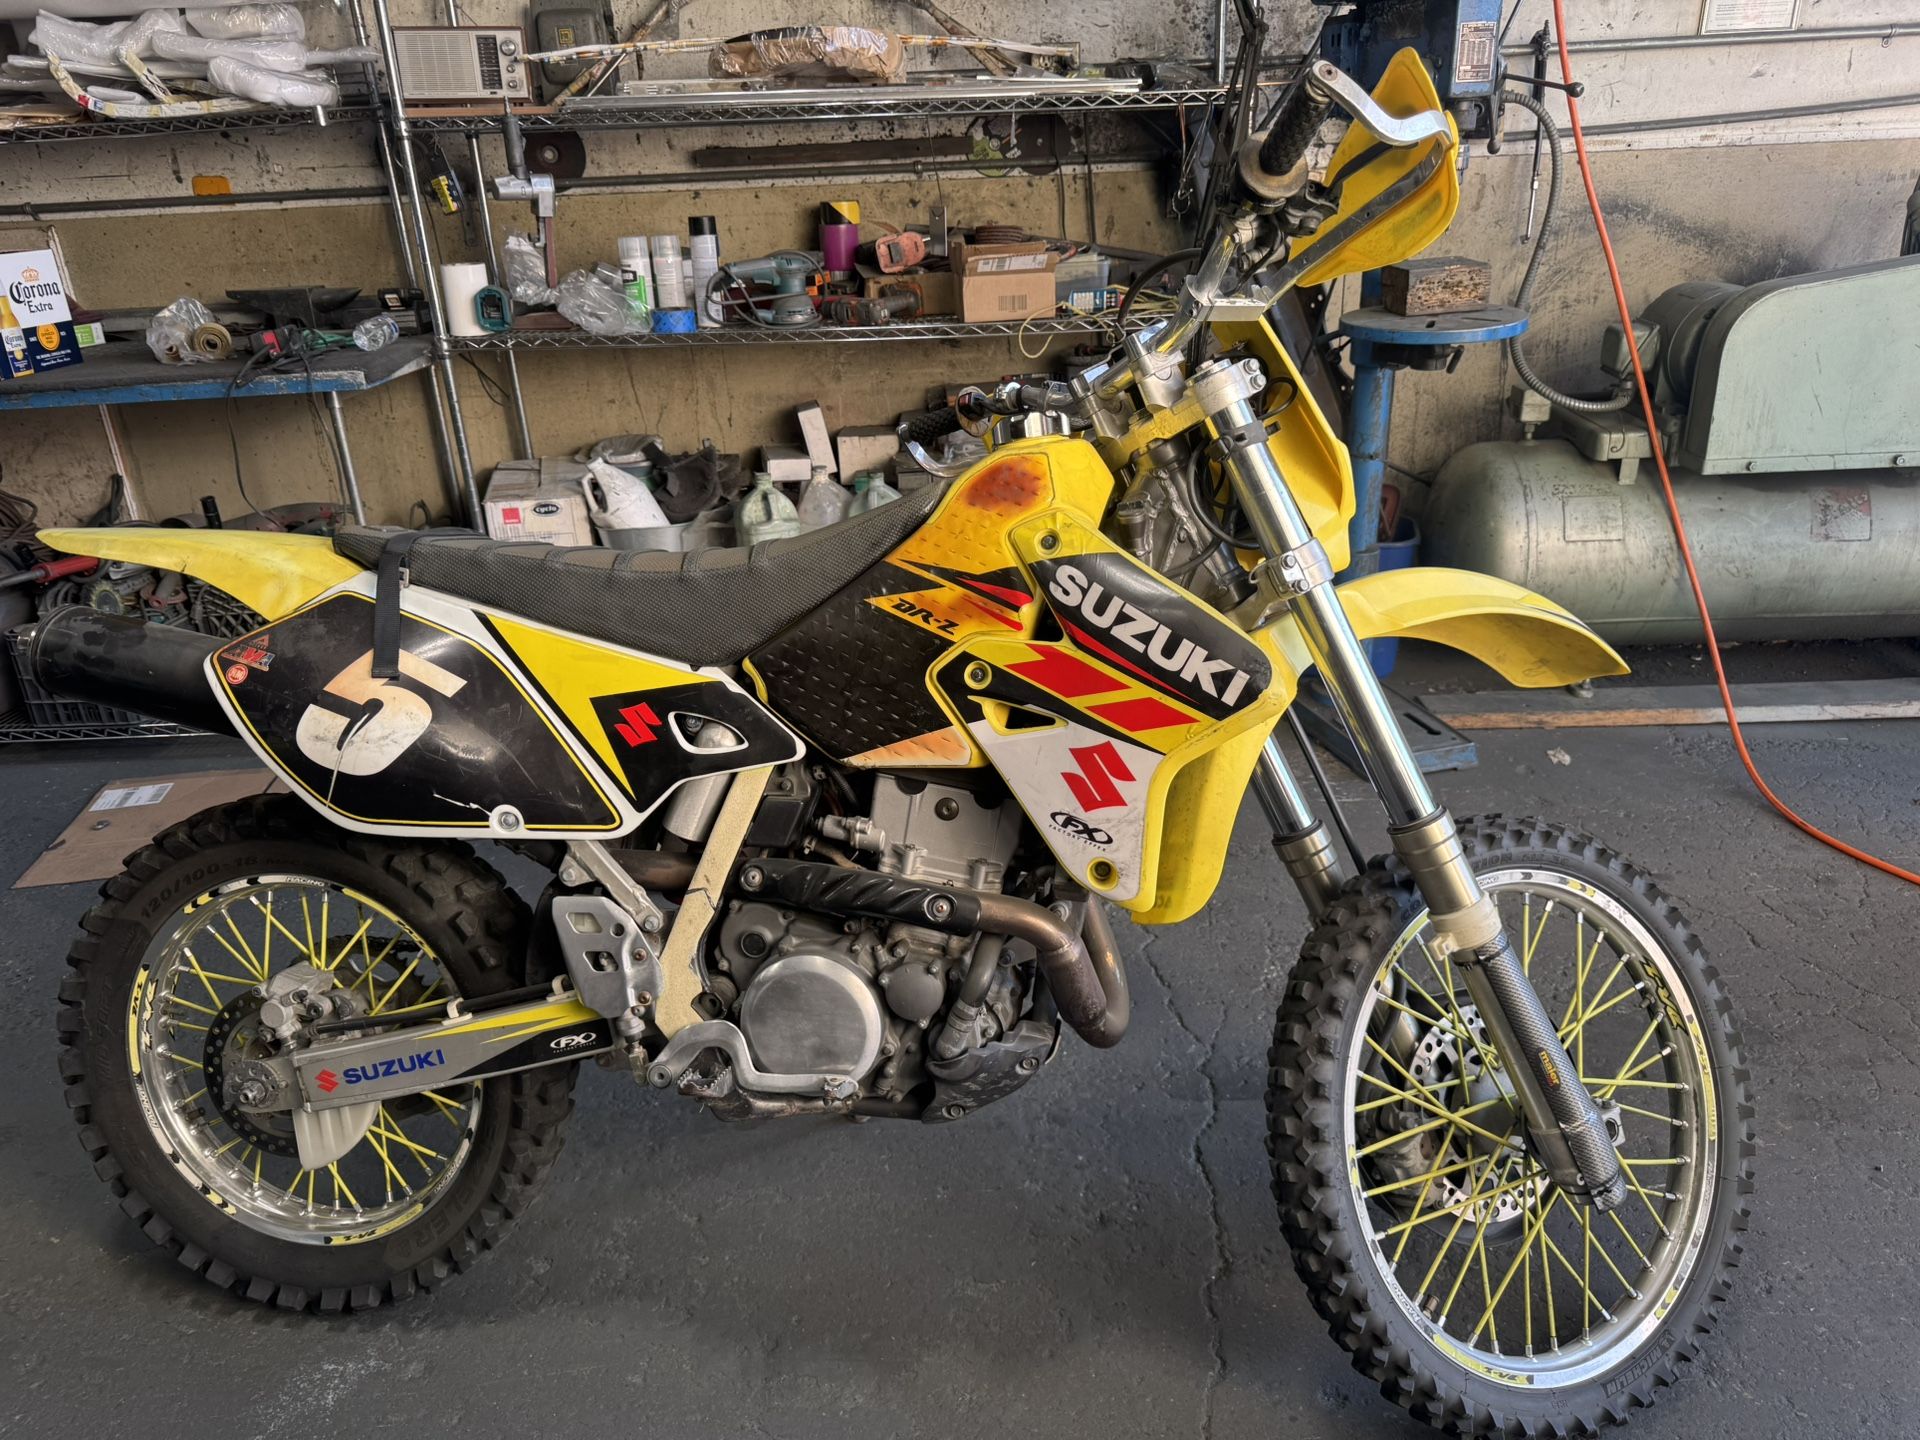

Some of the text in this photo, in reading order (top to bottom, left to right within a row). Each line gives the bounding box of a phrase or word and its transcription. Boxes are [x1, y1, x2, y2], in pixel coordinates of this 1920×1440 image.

[9, 281, 61, 304] Corona
[24, 301, 54, 313] Extra
[891, 597, 960, 636] DR-Z
[1049, 564, 1250, 707] SUZUKI
[296, 648, 468, 776] 5
[343, 1049, 445, 1085] SUZUKI
[1605, 1344, 1663, 1396] MICHELIN
